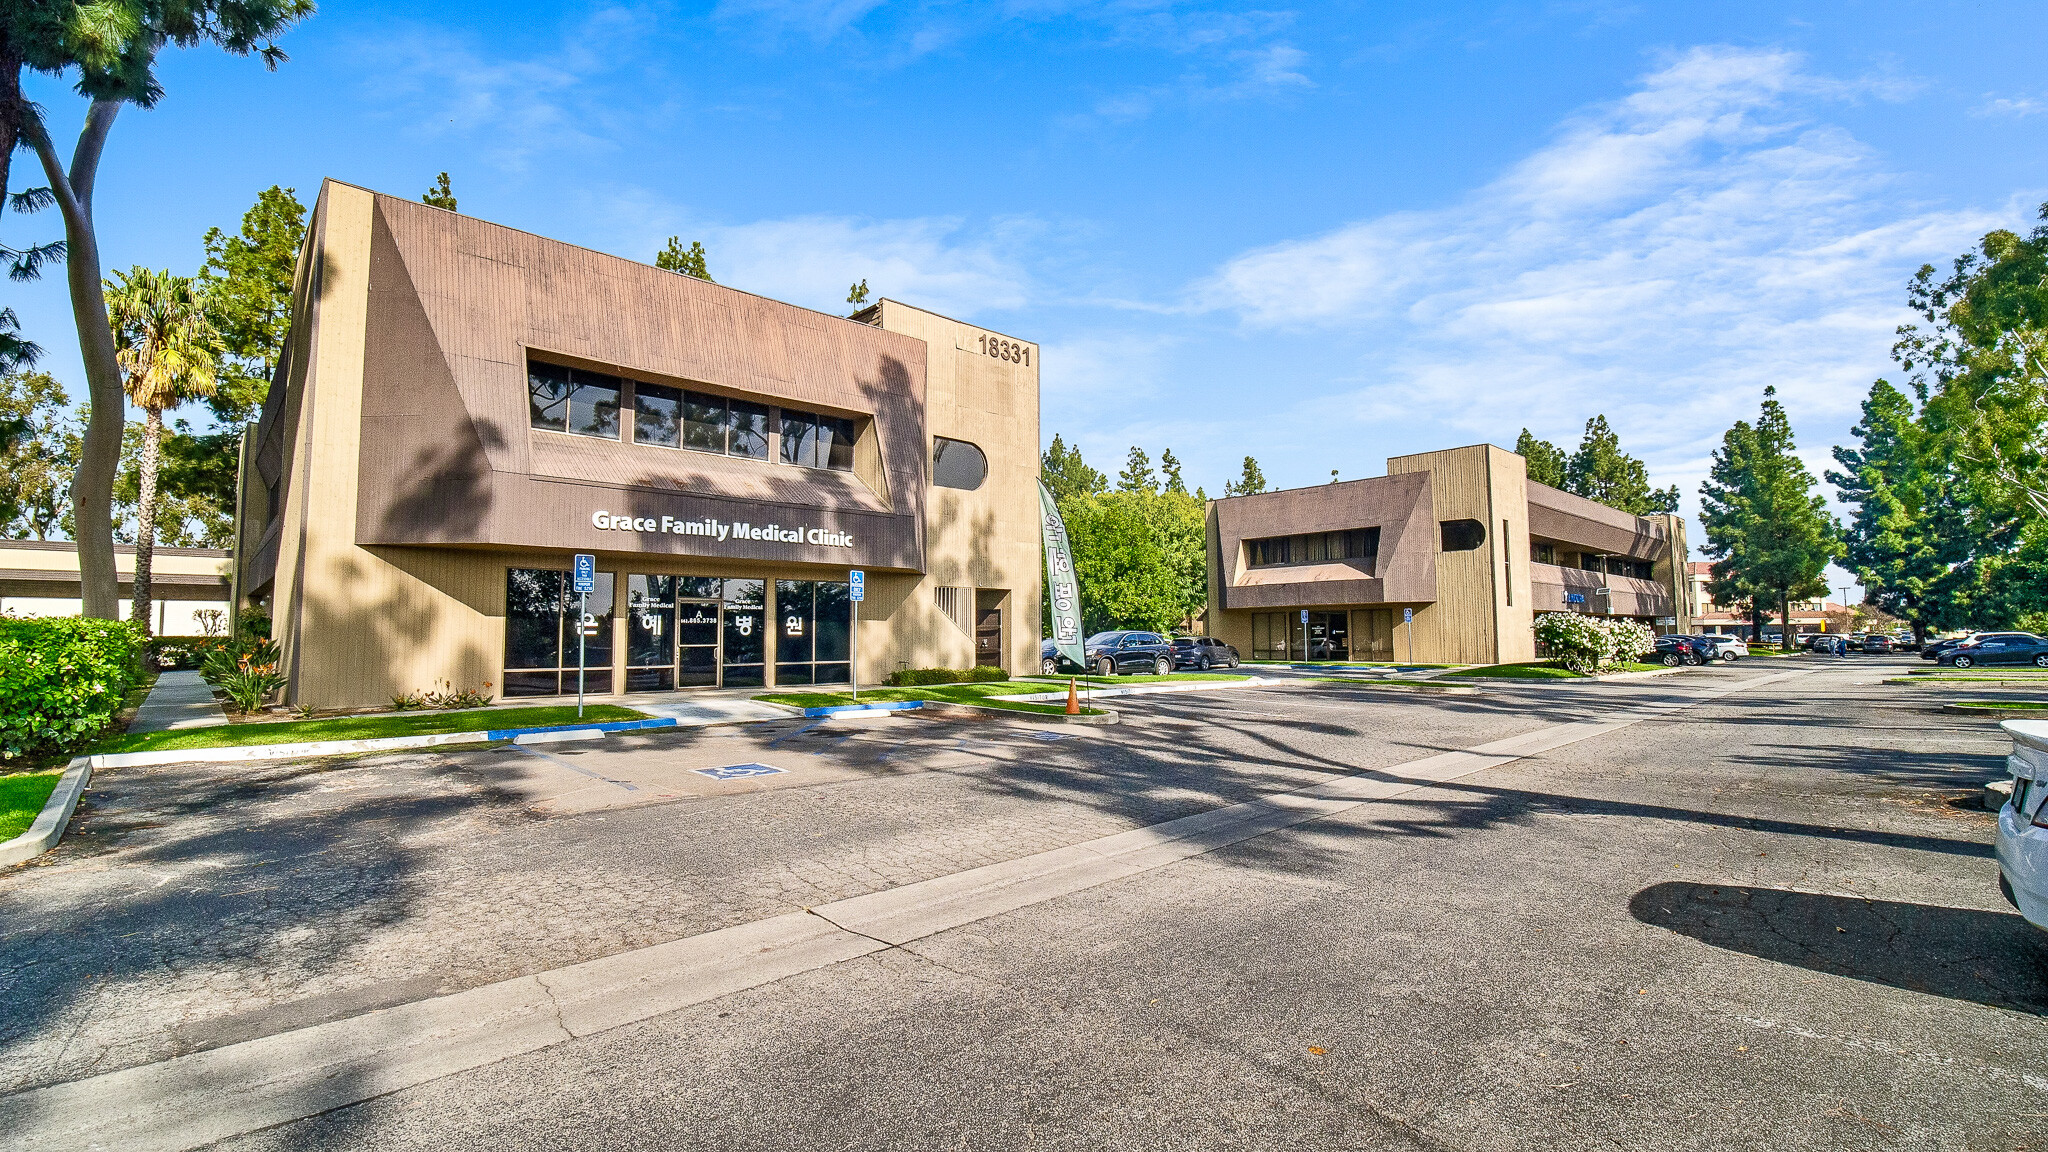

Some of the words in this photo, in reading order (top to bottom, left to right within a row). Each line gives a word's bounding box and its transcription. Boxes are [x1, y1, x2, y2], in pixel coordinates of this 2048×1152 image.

[979, 334, 1029, 367] 18331
[592, 511, 656, 532] Grace
[661, 515, 729, 542] Family
[732, 523, 803, 544] Medical
[807, 528, 853, 547] Clinic
[696, 610, 703, 618] A
